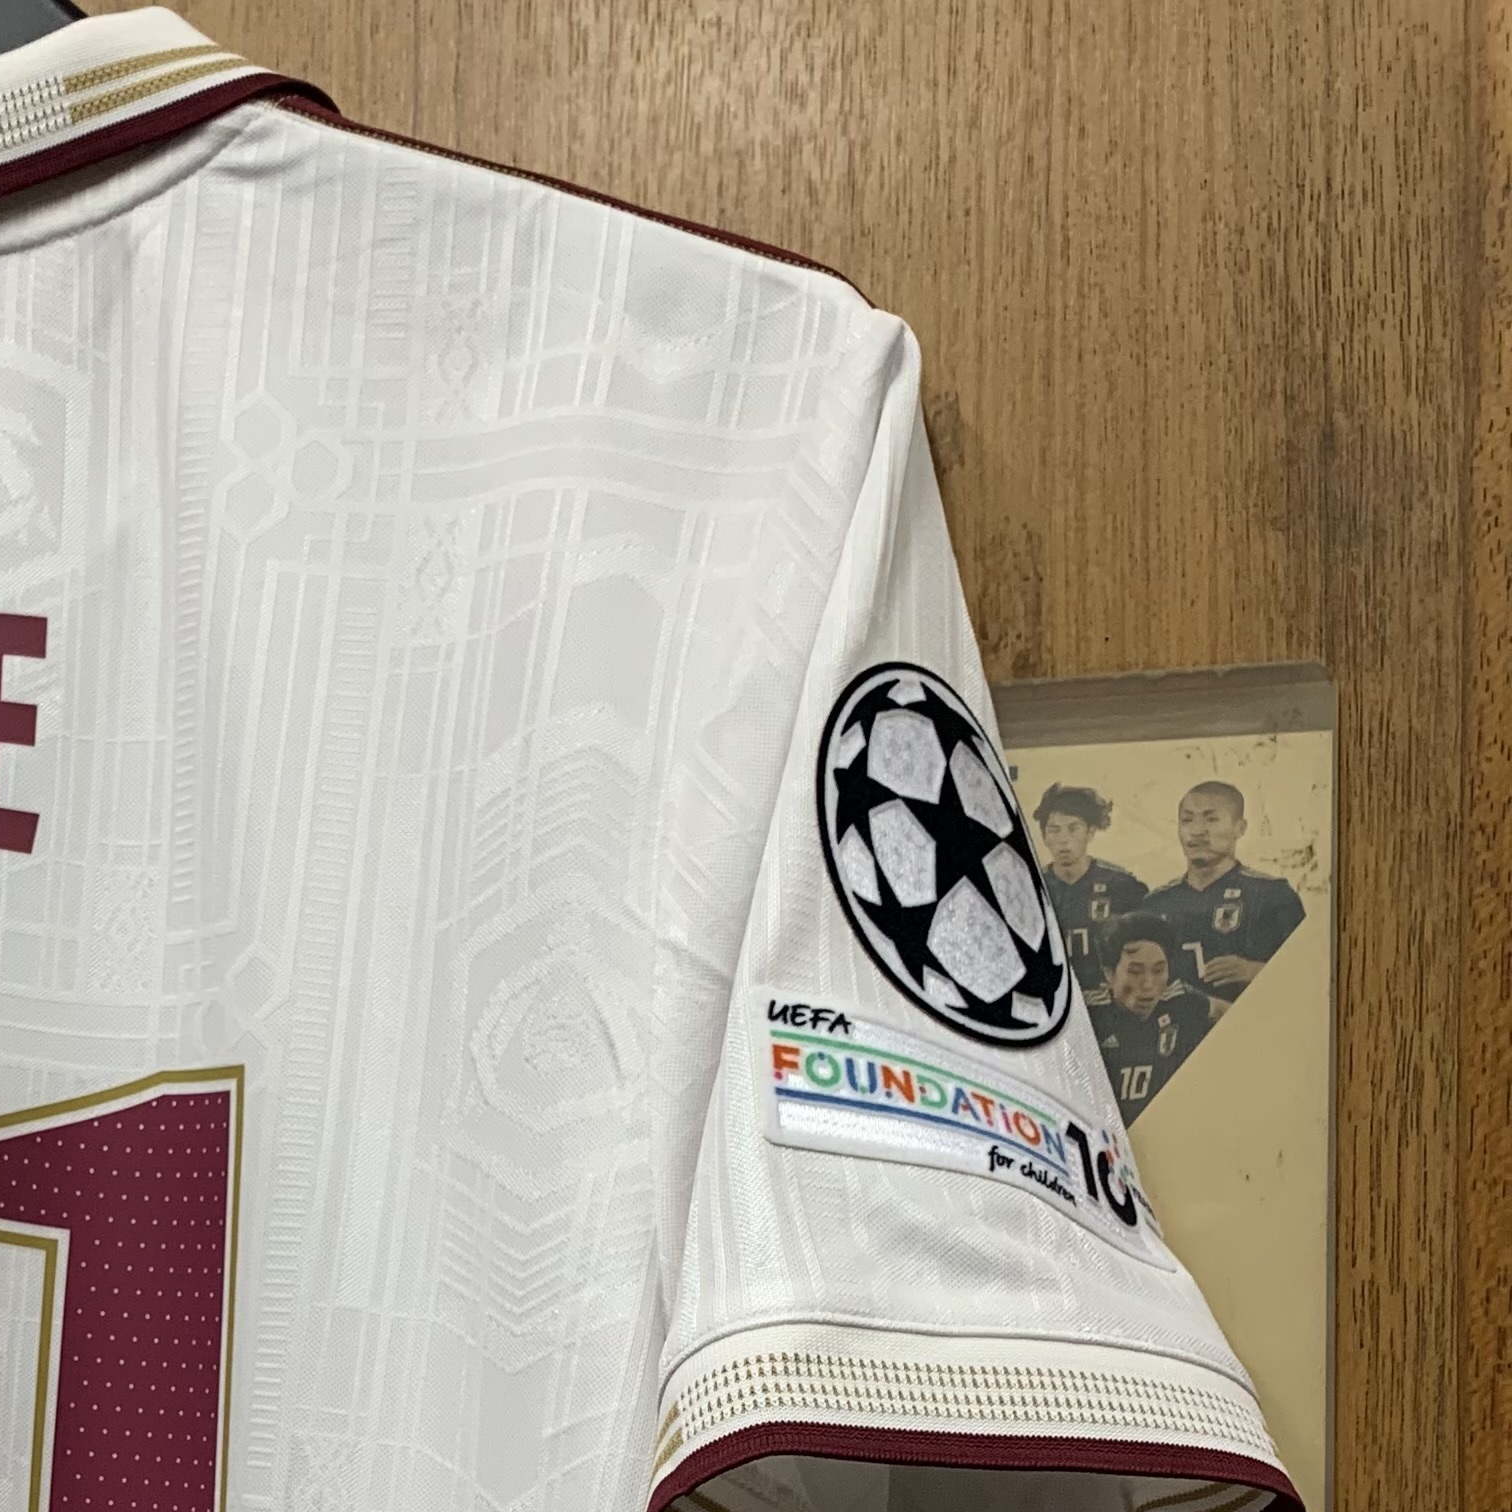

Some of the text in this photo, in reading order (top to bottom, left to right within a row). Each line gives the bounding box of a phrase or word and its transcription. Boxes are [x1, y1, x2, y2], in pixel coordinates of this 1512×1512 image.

[767, 999, 852, 1036] UEFA
[771, 1043, 1068, 1166] FOUNDATION
[1120, 1065, 1153, 1100] 10
[988, 1145, 1078, 1207] for children
